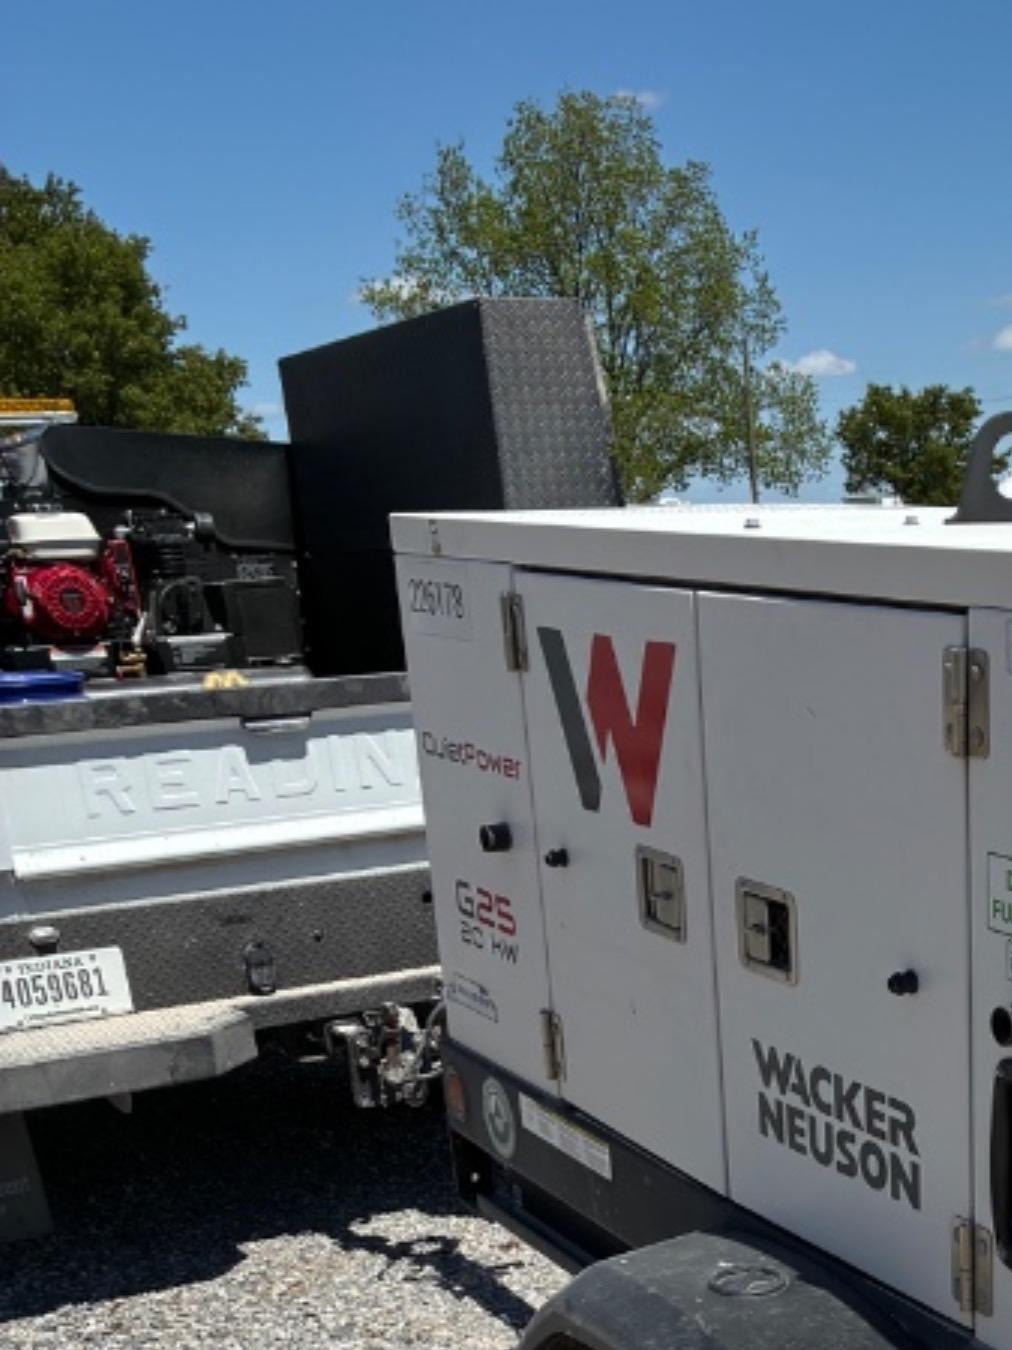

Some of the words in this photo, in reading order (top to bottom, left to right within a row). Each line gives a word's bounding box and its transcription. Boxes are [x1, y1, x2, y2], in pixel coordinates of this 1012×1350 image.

[422, 731, 521, 781] QuietPower
[455, 879, 517, 937] G25
[1, 967, 109, 1009] 4059681
[752, 1037, 921, 1158] WACKER
[758, 1091, 922, 1212] NEUSON
